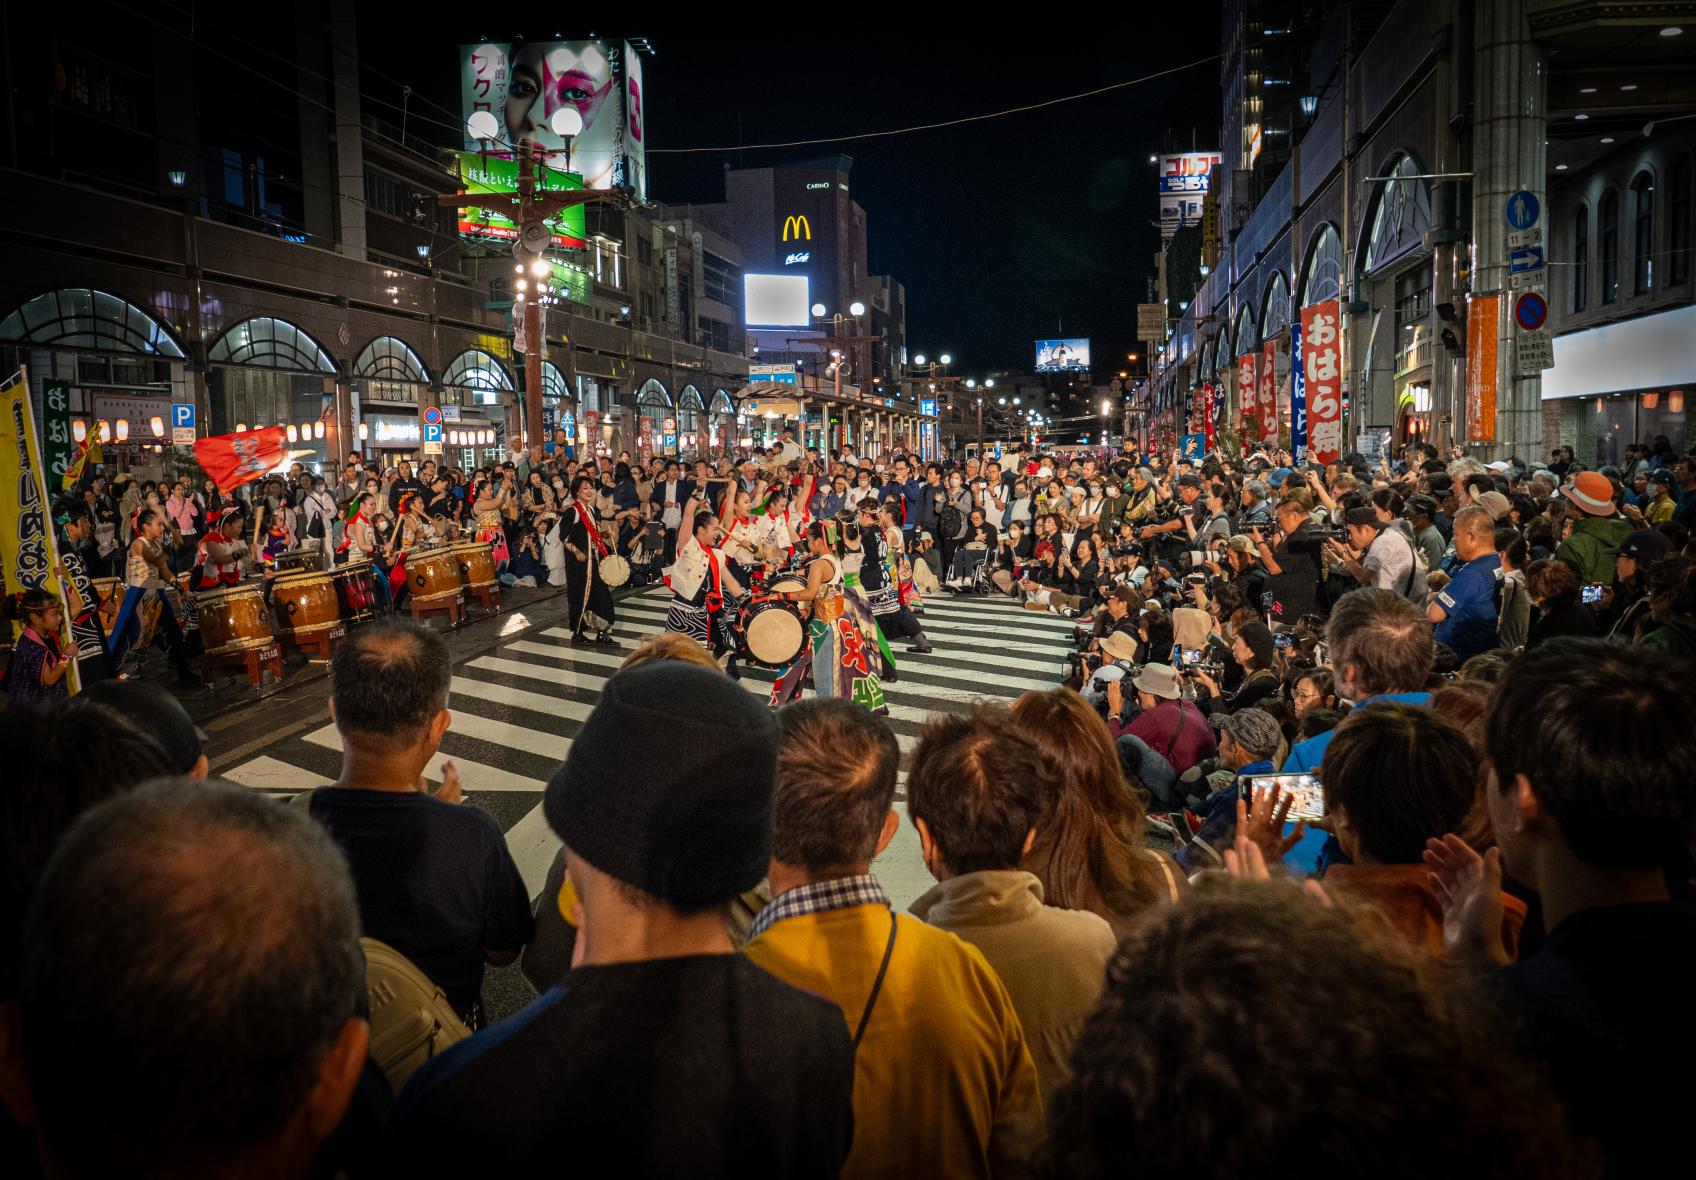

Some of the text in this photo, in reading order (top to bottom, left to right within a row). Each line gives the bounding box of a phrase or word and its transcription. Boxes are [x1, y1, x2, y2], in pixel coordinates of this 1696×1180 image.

[1514, 277, 1519, 286] 2
[1535, 273, 1543, 281] 11
[1307, 313, 1340, 454] おはら祭
[177, 406, 191, 425] P
[428, 426, 438, 440] P
[667, 435, 673, 445] P
